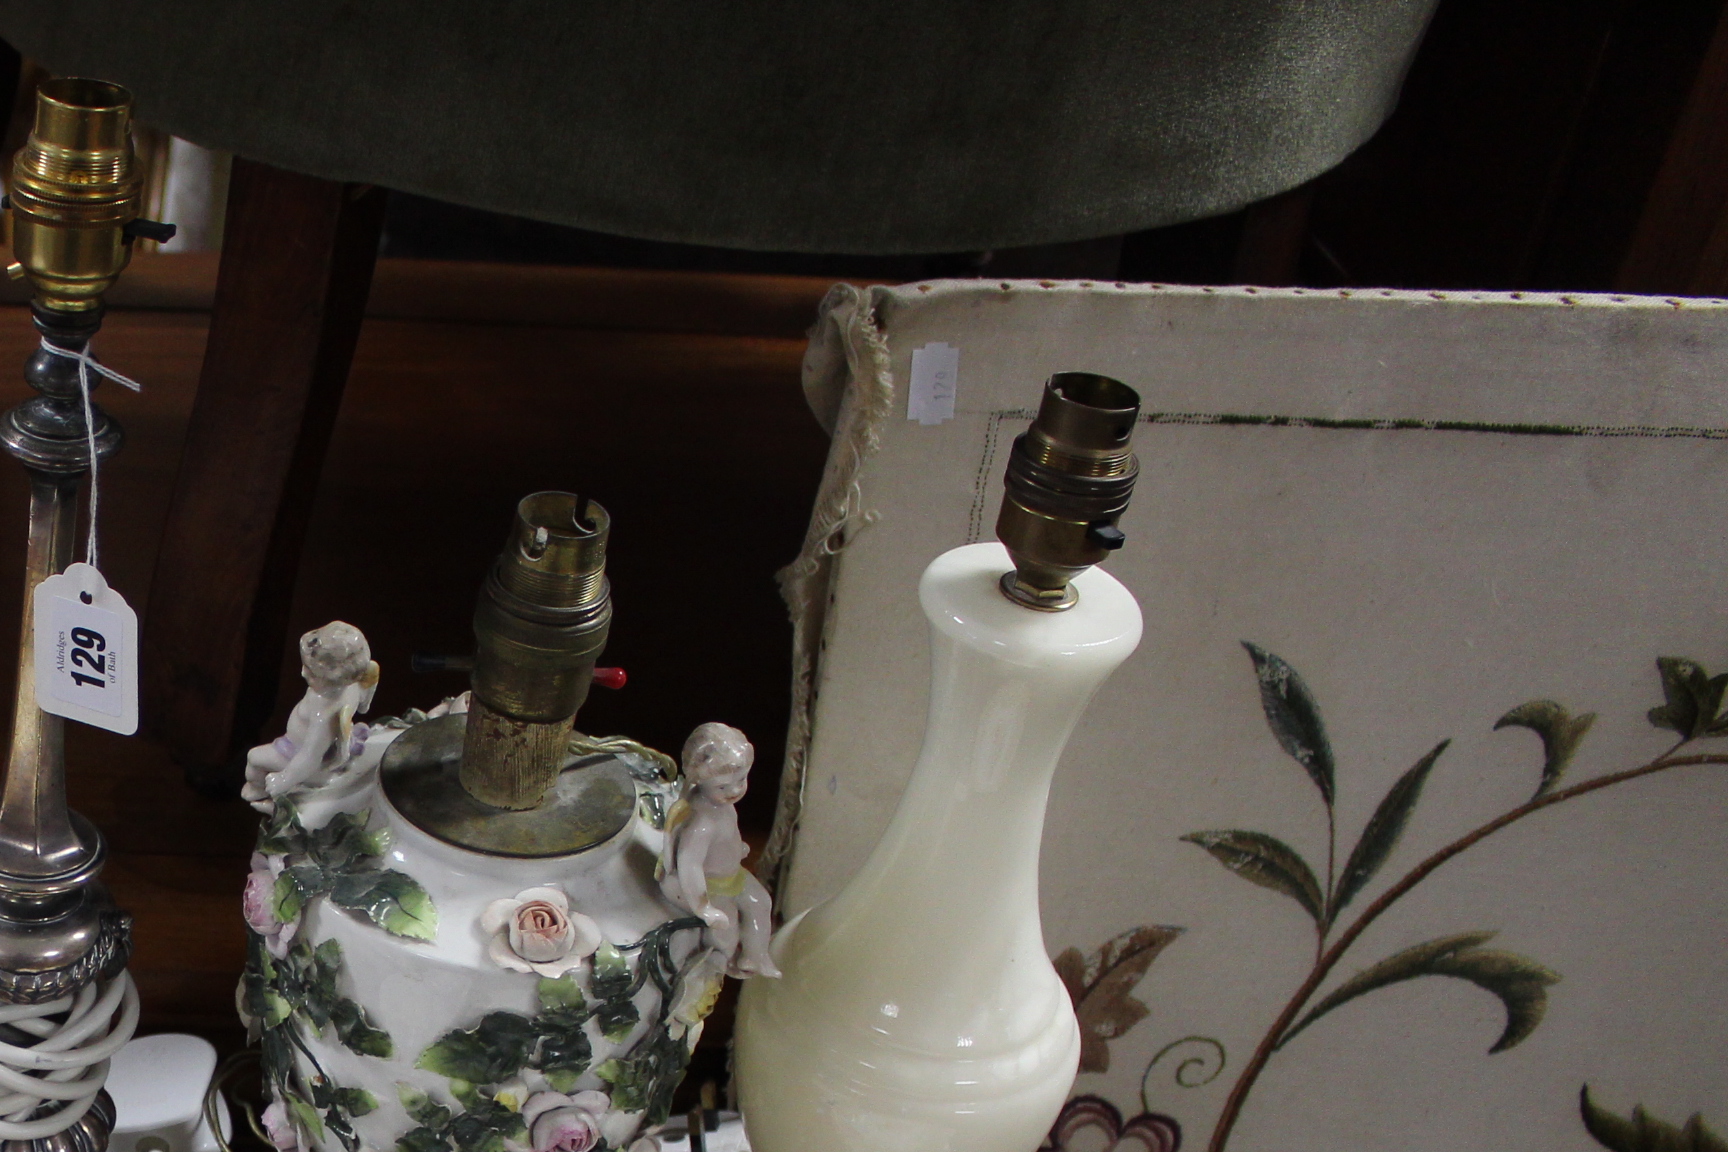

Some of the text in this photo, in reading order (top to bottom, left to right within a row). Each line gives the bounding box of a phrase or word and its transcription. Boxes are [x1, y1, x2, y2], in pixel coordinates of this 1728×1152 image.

[56, 630, 67, 673] Aldridges
[70, 626, 106, 689] 129
[107, 651, 116, 684] of Bath
